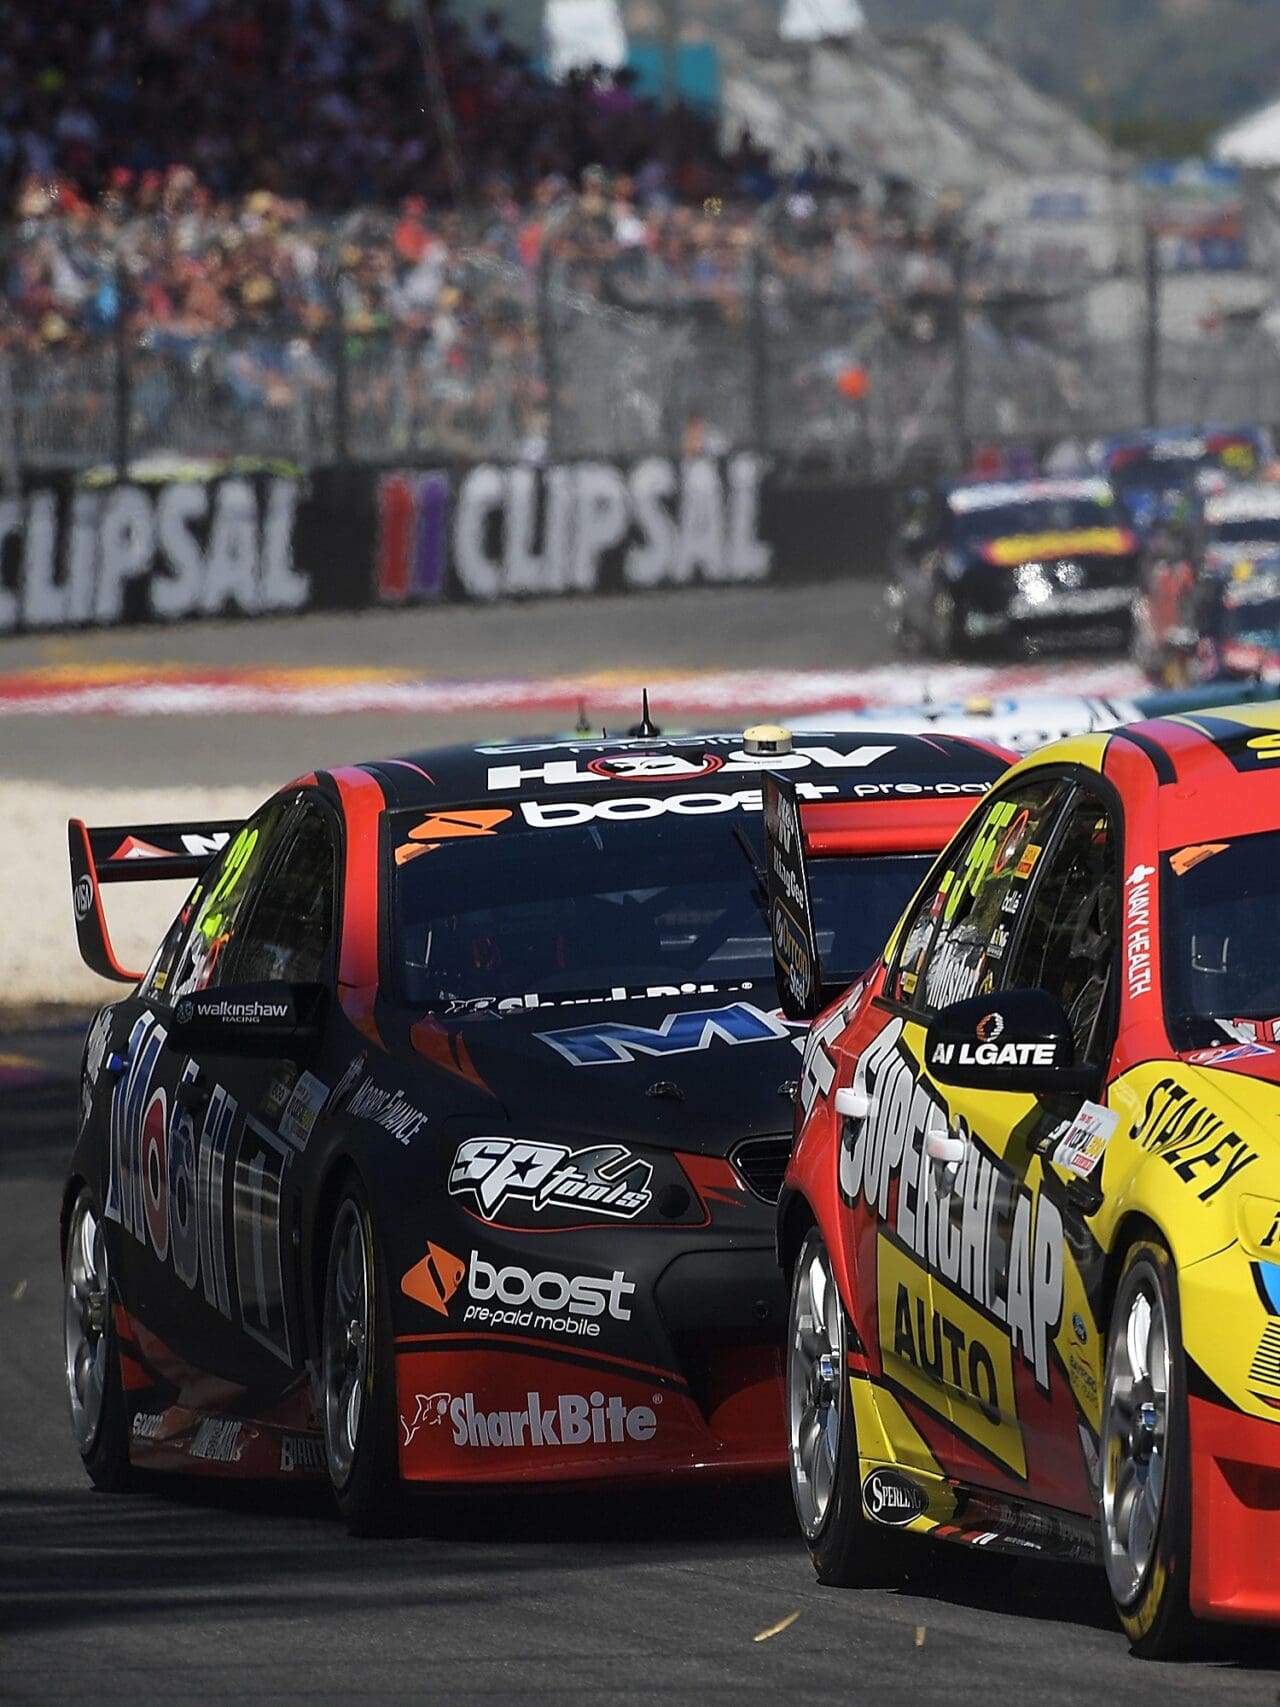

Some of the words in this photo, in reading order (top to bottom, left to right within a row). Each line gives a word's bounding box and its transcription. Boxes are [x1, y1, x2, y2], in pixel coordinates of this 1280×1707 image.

[0, 477, 310, 629] LIPSAL
[453, 450, 774, 600] CLIPSAL
[1127, 881, 1150, 929] NAVY
[1127, 928, 1151, 1000] HEALTH
[197, 1001, 288, 1017] walkinshaw
[221, 1015, 261, 1024] RACING
[1129, 1077, 1259, 1203] STANLEY
[468, 1250, 636, 1322] boost
[533, 1313, 601, 1337] mobile
[893, 1279, 1002, 1429] AUTO
[449, 1392, 658, 1447] SharkBite
